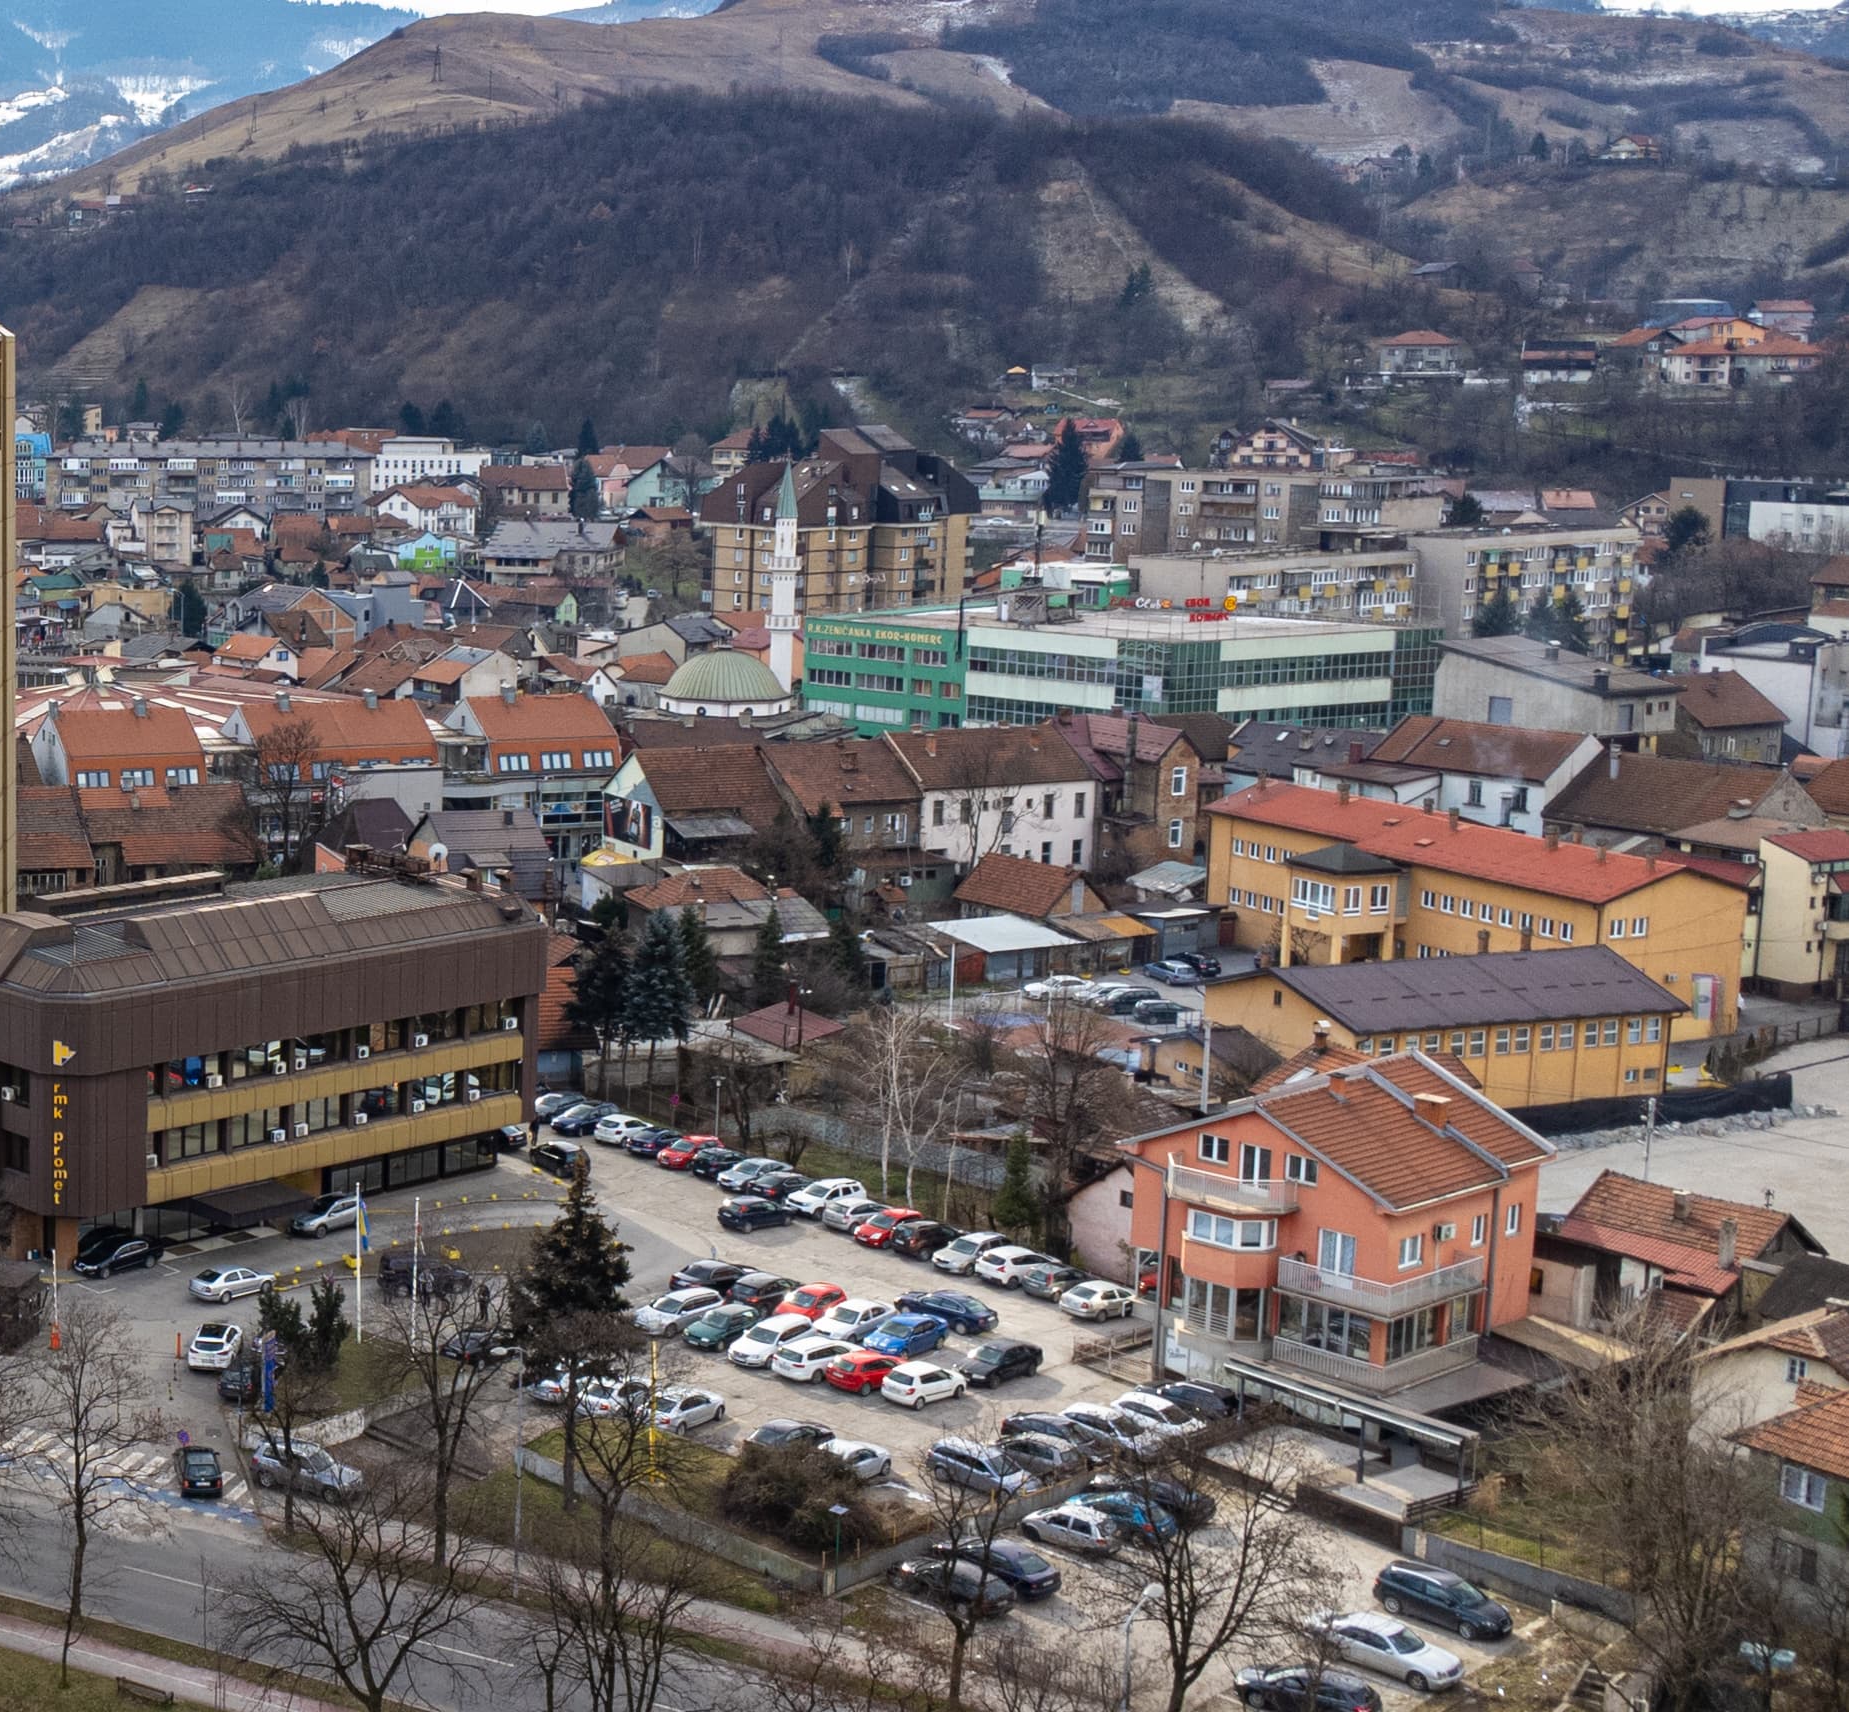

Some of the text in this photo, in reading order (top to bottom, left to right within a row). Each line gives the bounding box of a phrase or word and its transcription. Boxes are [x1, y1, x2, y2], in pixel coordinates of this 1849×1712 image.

[1135, 597, 1161, 609] Club
[53, 1083, 68, 1205] rmk promet
